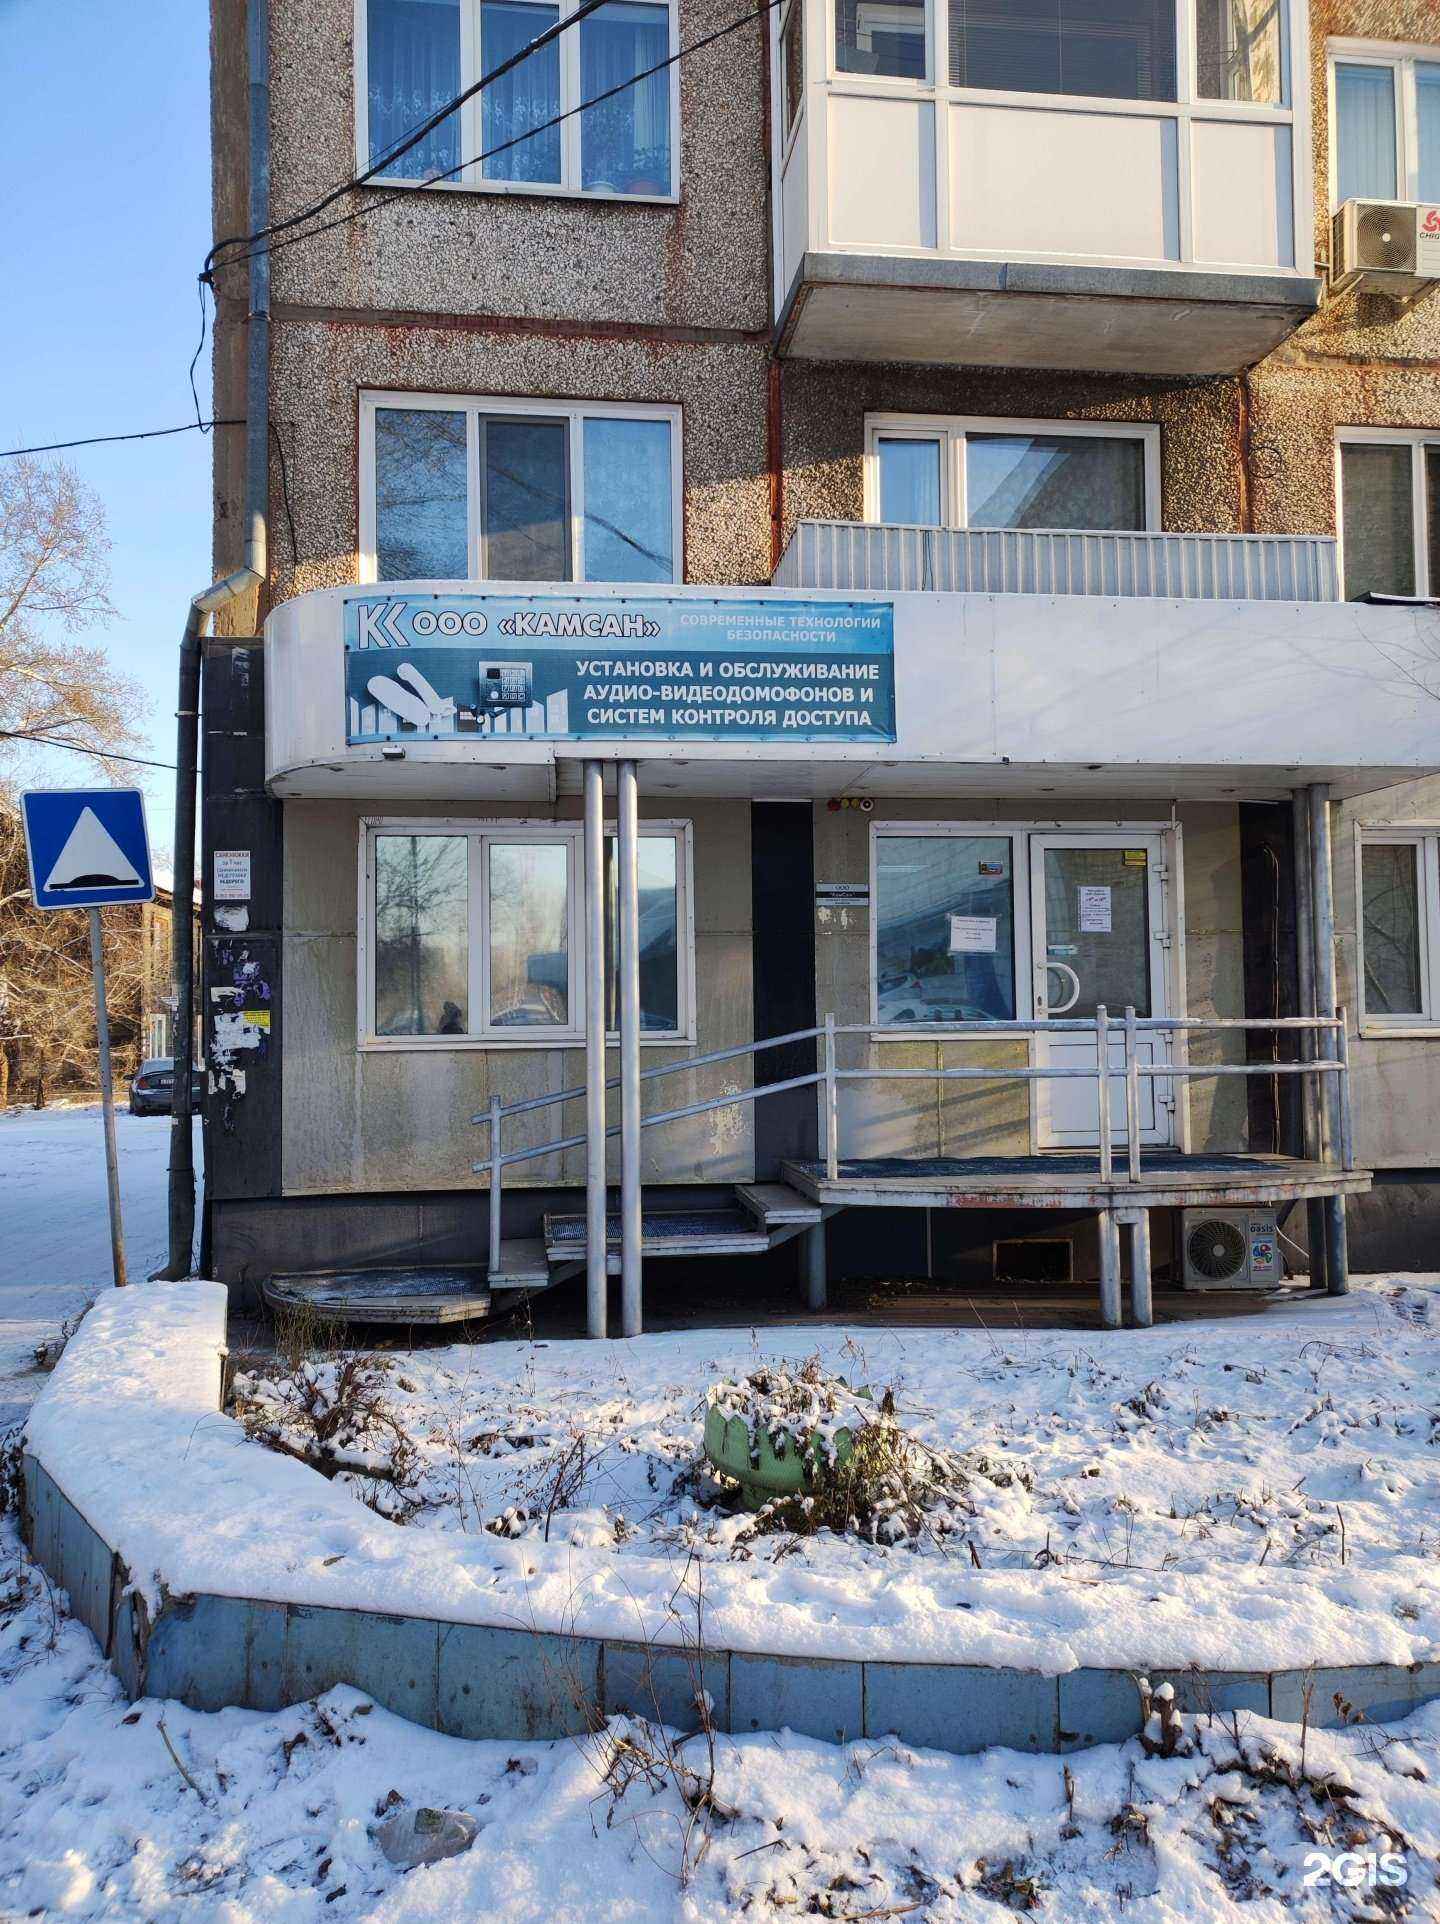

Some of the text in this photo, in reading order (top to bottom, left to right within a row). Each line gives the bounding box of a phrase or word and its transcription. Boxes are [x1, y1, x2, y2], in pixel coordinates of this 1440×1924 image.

[412, 611, 488, 636] ООО
[498, 612, 661, 638] «КАМСАН»
[680, 614, 881, 629] СОВРЕМЕННЫЕ ТЕХНОЛОГИИ
[727, 630, 836, 642] БЕЗОПАСНОСТИ
[576, 660, 880, 680] УСТАНОВКА И ОБСЛУЖИВАНИЕ
[583, 684, 874, 704] АУДИО-ВИДЕОДОМОФОНОВ И
[587, 708, 872, 728] СИСТЕМ КОНТРОЛЯ ДОСТУПА
